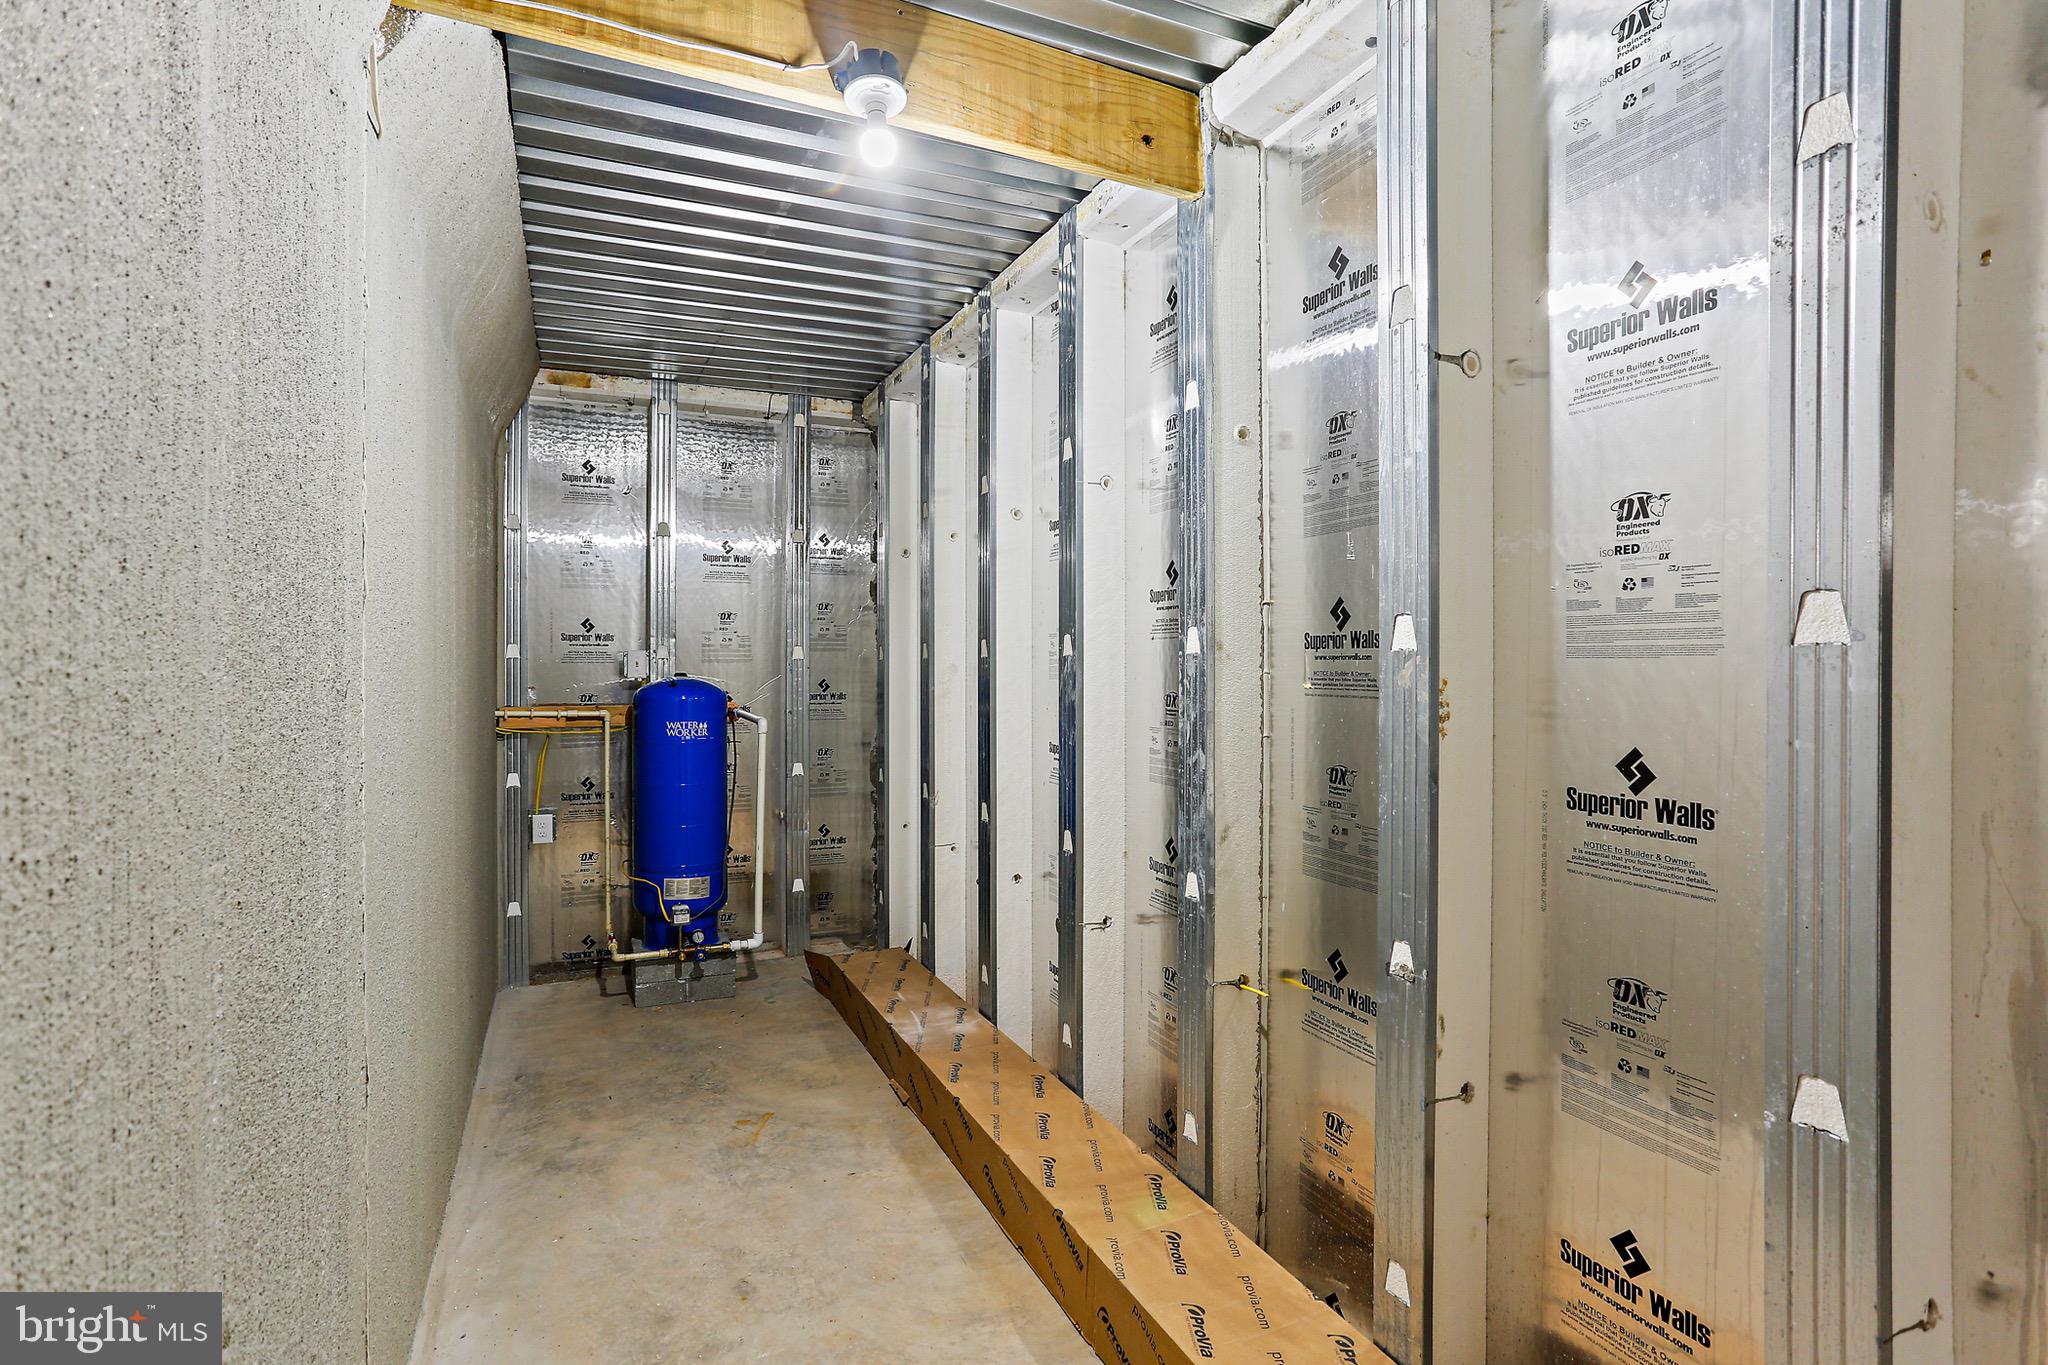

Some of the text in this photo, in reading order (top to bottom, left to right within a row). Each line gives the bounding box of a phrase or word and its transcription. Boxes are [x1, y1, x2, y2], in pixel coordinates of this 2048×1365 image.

[1617, 22, 1662, 53] Engineered
[1617, 37, 1651, 59] Products
[1303, 264, 1378, 314] Superior Walls
[1150, 312, 1177, 337] Superior
[1567, 288, 1718, 353] Superior Walls
[1587, 323, 1700, 362] www.superiorwalls.com
[1585, 369, 1614, 384] NOTICE
[1626, 360, 1655, 372] Builder
[1658, 356, 1664, 364] &
[1667, 348, 1698, 361] Owner:
[1586, 379, 1612, 390] essential
[1613, 375, 1625, 383] that
[1626, 373, 1638, 381] you
[1640, 367, 1658, 376] follow
[1660, 359, 1689, 371] Superior
[1691, 354, 1710, 363] Walls
[1573, 390, 1600, 401] published
[1602, 382, 1633, 394] guidelines
[1645, 368, 1687, 382] construction
[561, 473, 615, 485] Superior Walls
[1616, 519, 1660, 531] Engineered
[1616, 528, 1650, 537] Products
[703, 553, 752, 563] Superior Walls
[1659, 552, 1670, 560] OX
[1150, 587, 1177, 603] Superior
[561, 633, 615, 642] Superior Walls
[1304, 630, 1379, 652] Superior Walls
[1314, 653, 1372, 662] www.superiorwalls.com
[830, 692, 847, 700] Walls
[666, 721, 699, 729] WATER
[561, 792, 593, 802] Superior
[1566, 786, 1648, 820] Superior
[830, 836, 847, 845] Walls
[1586, 820, 1697, 845] www.superiorwalls.com
[733, 855, 751, 863] Walls
[1149, 856, 1176, 877] Superior
[1584, 841, 1612, 852] NOTICE
[1624, 848, 1654, 859] Builder
[1664, 855, 1696, 868] Owner:
[1584, 850, 1610, 859] essential
[1637, 859, 1656, 867] follow
[1658, 863, 1687, 874] Superior
[1688, 868, 1707, 877] Walls
[1572, 855, 1599, 864] published
[1600, 861, 1631, 871] guidelines
[1643, 868, 1684, 881] construction
[1686, 876, 1711, 886] details.
[562, 948, 594, 960] Superior
[1301, 968, 1377, 1017] Superior Walls
[1612, 1001, 1657, 1022] Engineered
[1612, 1008, 1646, 1025] Products
[1654, 1049, 1666, 1059] OX
[1033, 1077, 1045, 1099] ProVia
[1037, 1115, 1050, 1140] ProVia
[1088, 1140, 1103, 1172] provia.com
[1002, 1157, 1029, 1214] provia.com
[1042, 1160, 1055, 1188] ProVia
[985, 1170, 1006, 1216] ProVia
[1096, 1184, 1114, 1222] provia.com
[1148, 1178, 1167, 1211] ProVia
[1057, 1216, 1083, 1272] ProVia
[1213, 1212, 1241, 1258] provia.com
[1036, 1233, 1066, 1298] provia.com
[1106, 1237, 1126, 1280] provia.com
[1165, 1236, 1187, 1275] ProVia
[1237, 1275, 1270, 1329] provia.com
[1560, 1238, 1643, 1305] Superior
[1649, 1289, 1711, 1349] Walls
[1578, 1299, 1657, 1355] NOTICE to Builder &
[1580, 1280, 1693, 1356] www.superiorwalls.com
[1186, 1308, 1213, 1358] ProVia
